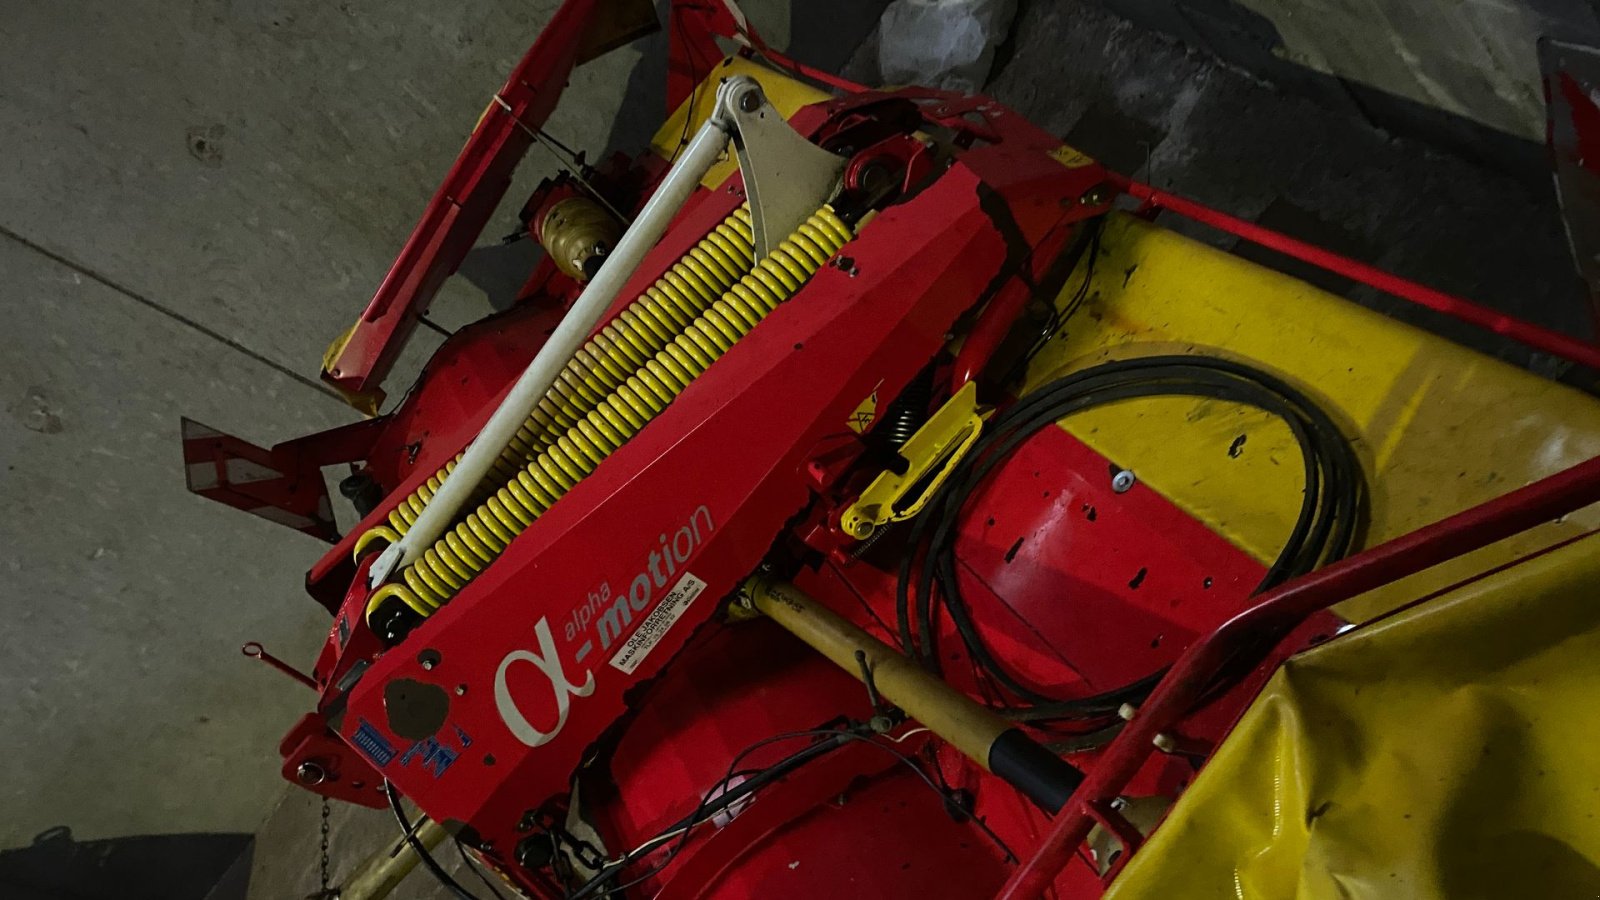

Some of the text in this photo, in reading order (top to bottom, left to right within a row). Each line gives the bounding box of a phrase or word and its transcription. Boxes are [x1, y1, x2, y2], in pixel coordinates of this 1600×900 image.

[564, 581, 611, 642] alpha
[619, 592, 684, 666] MASKINFORRETNING
[683, 579, 695, 593] A/S
[627, 631, 643, 648] OLE
[642, 591, 677, 632] JAKOBSEN
